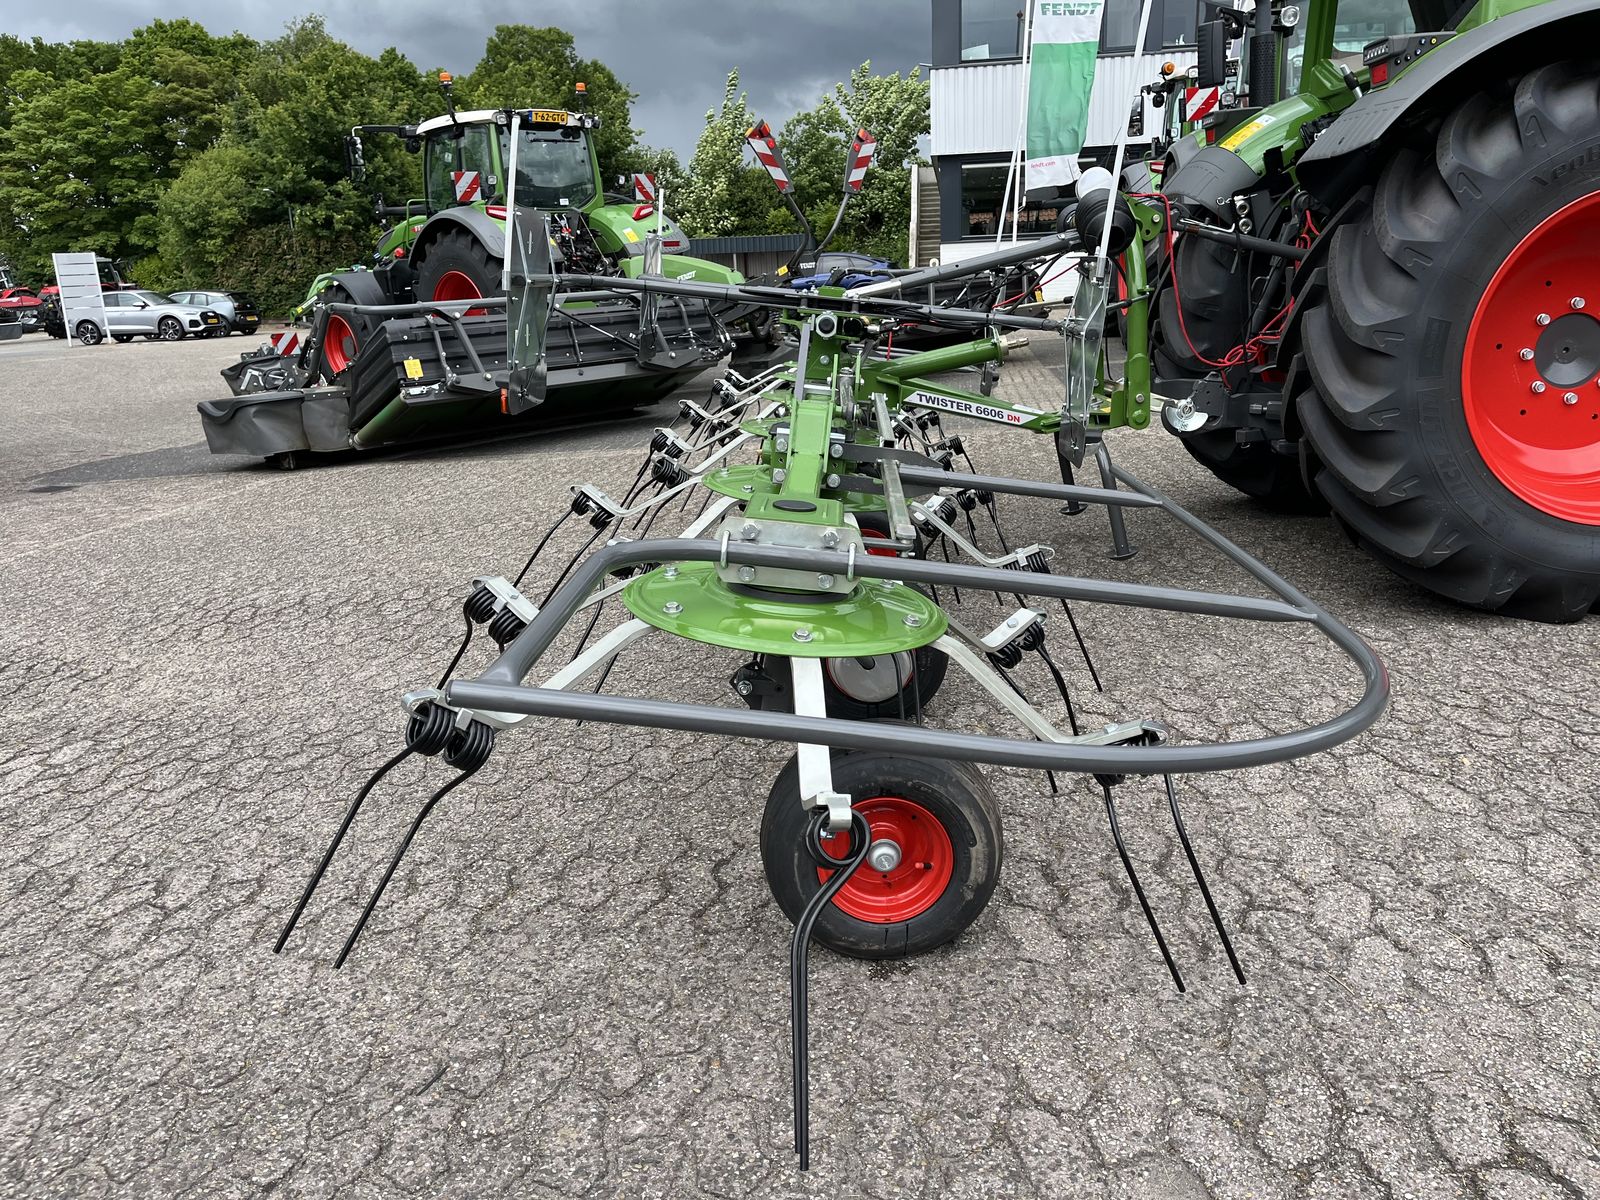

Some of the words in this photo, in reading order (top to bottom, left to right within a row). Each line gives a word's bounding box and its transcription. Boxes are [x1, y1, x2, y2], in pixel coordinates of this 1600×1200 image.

[1040, 2, 1102, 16] FENDT
[916, 393, 973, 413] TWISTER
[975, 405, 1005, 420] 6606
[1007, 414, 1021, 424] DN
